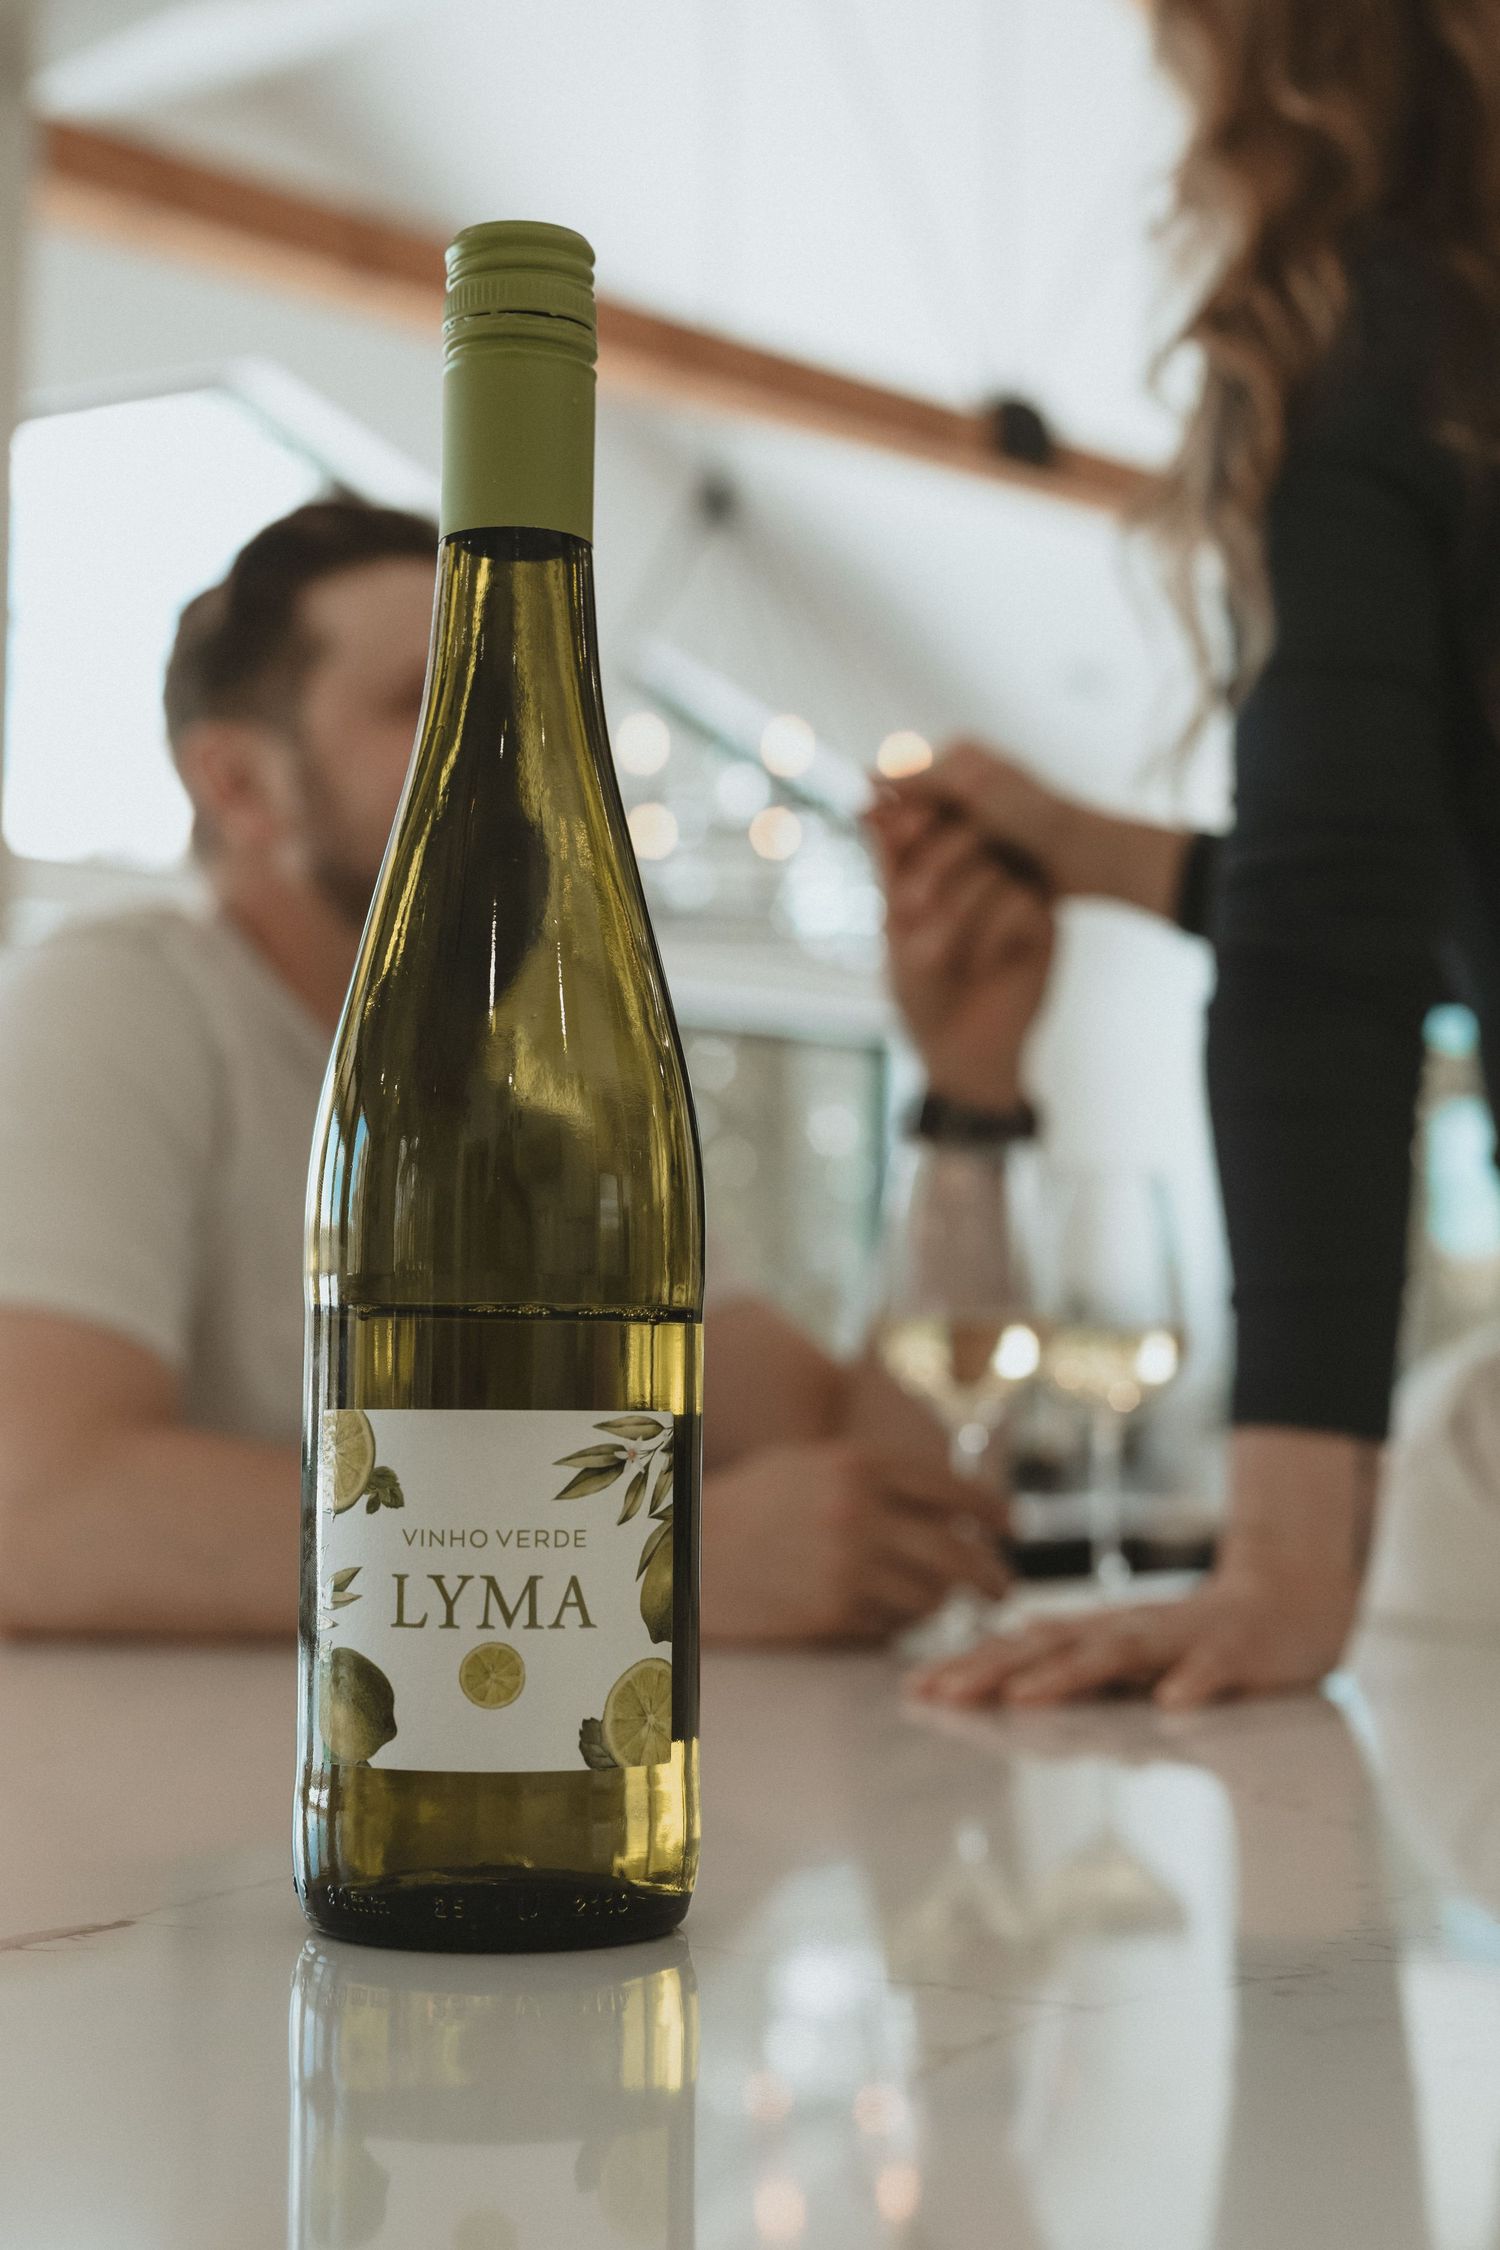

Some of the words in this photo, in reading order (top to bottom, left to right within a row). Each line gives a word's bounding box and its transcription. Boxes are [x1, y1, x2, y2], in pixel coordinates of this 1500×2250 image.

[402, 1528, 489, 1548] VINHO
[495, 1529, 587, 1549] VERDE
[390, 1573, 598, 1629] LYMA
